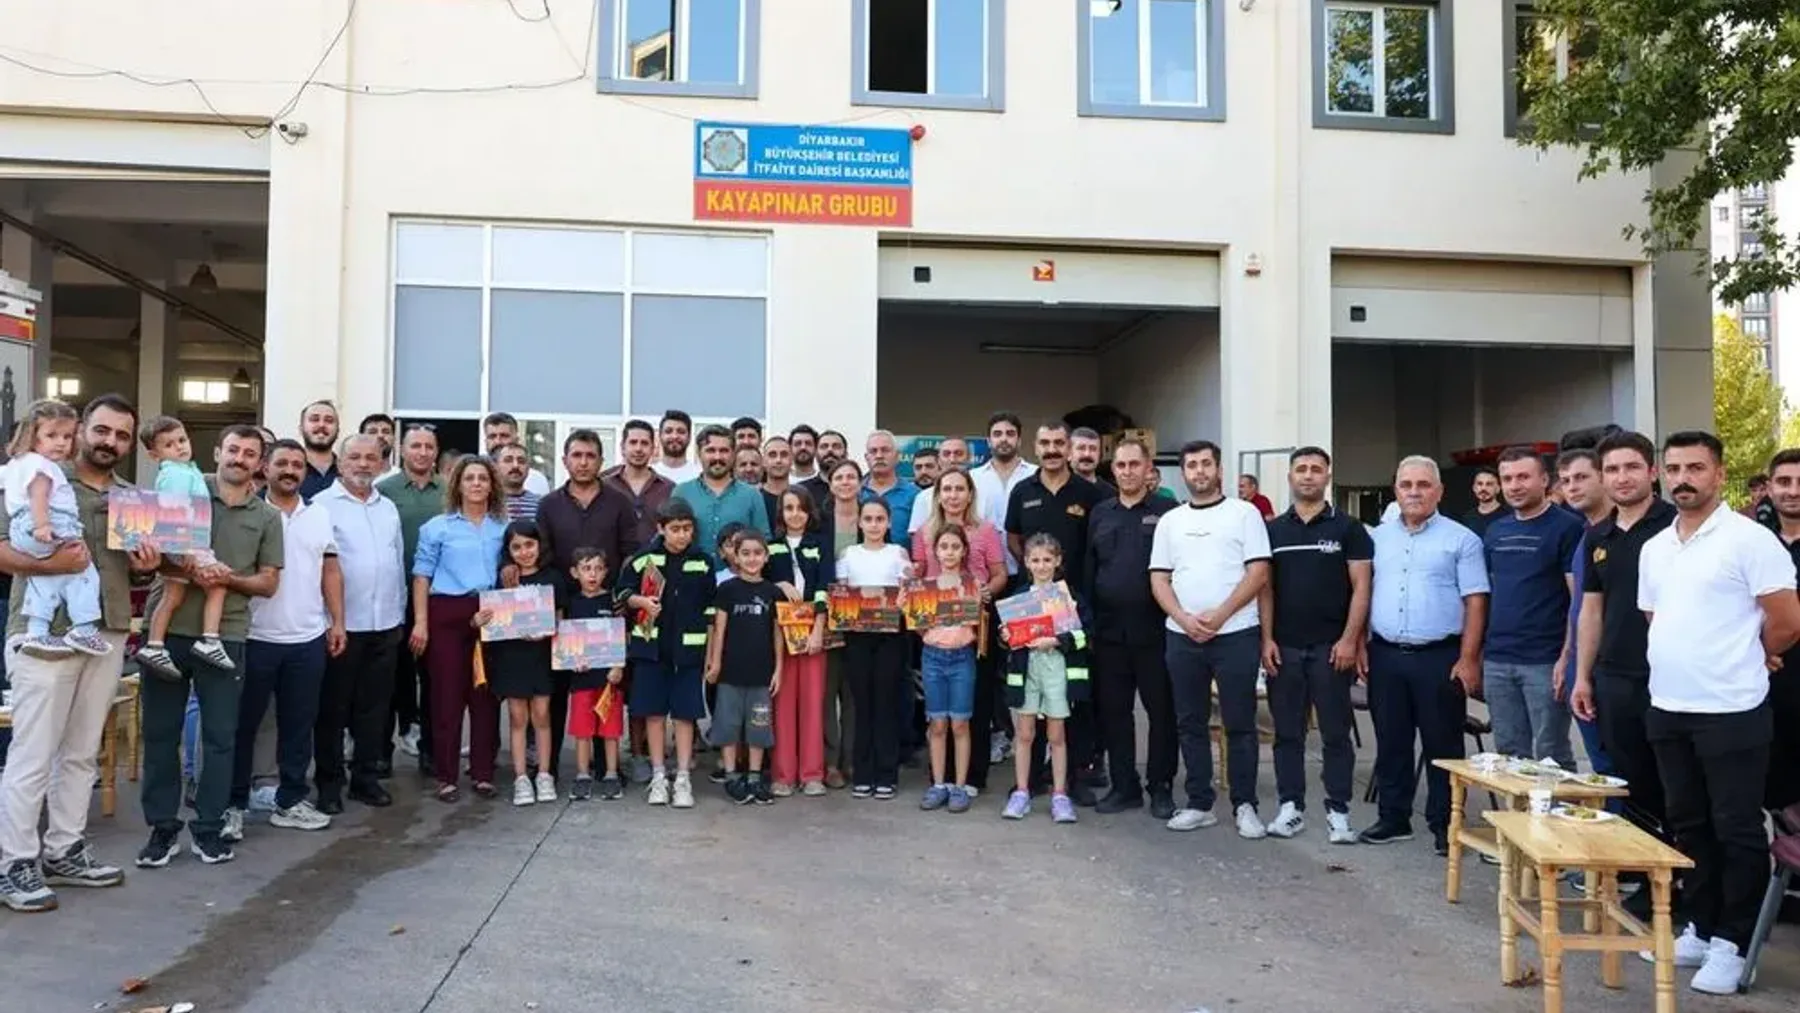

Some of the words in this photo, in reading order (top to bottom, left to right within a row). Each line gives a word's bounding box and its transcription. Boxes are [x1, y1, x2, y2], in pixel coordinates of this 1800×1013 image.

[799, 134, 865, 147] DİYARBAKIR
[765, 148, 834, 162] BÜYÜKŞEHİR
[837, 150, 900, 164] BELEDİYESİ
[754, 162, 796, 175] İTFAİYE
[799, 163, 842, 177] DAİRESİ
[706, 190, 825, 215] KAYAPINAR
[829, 195, 898, 217] GRUBU
